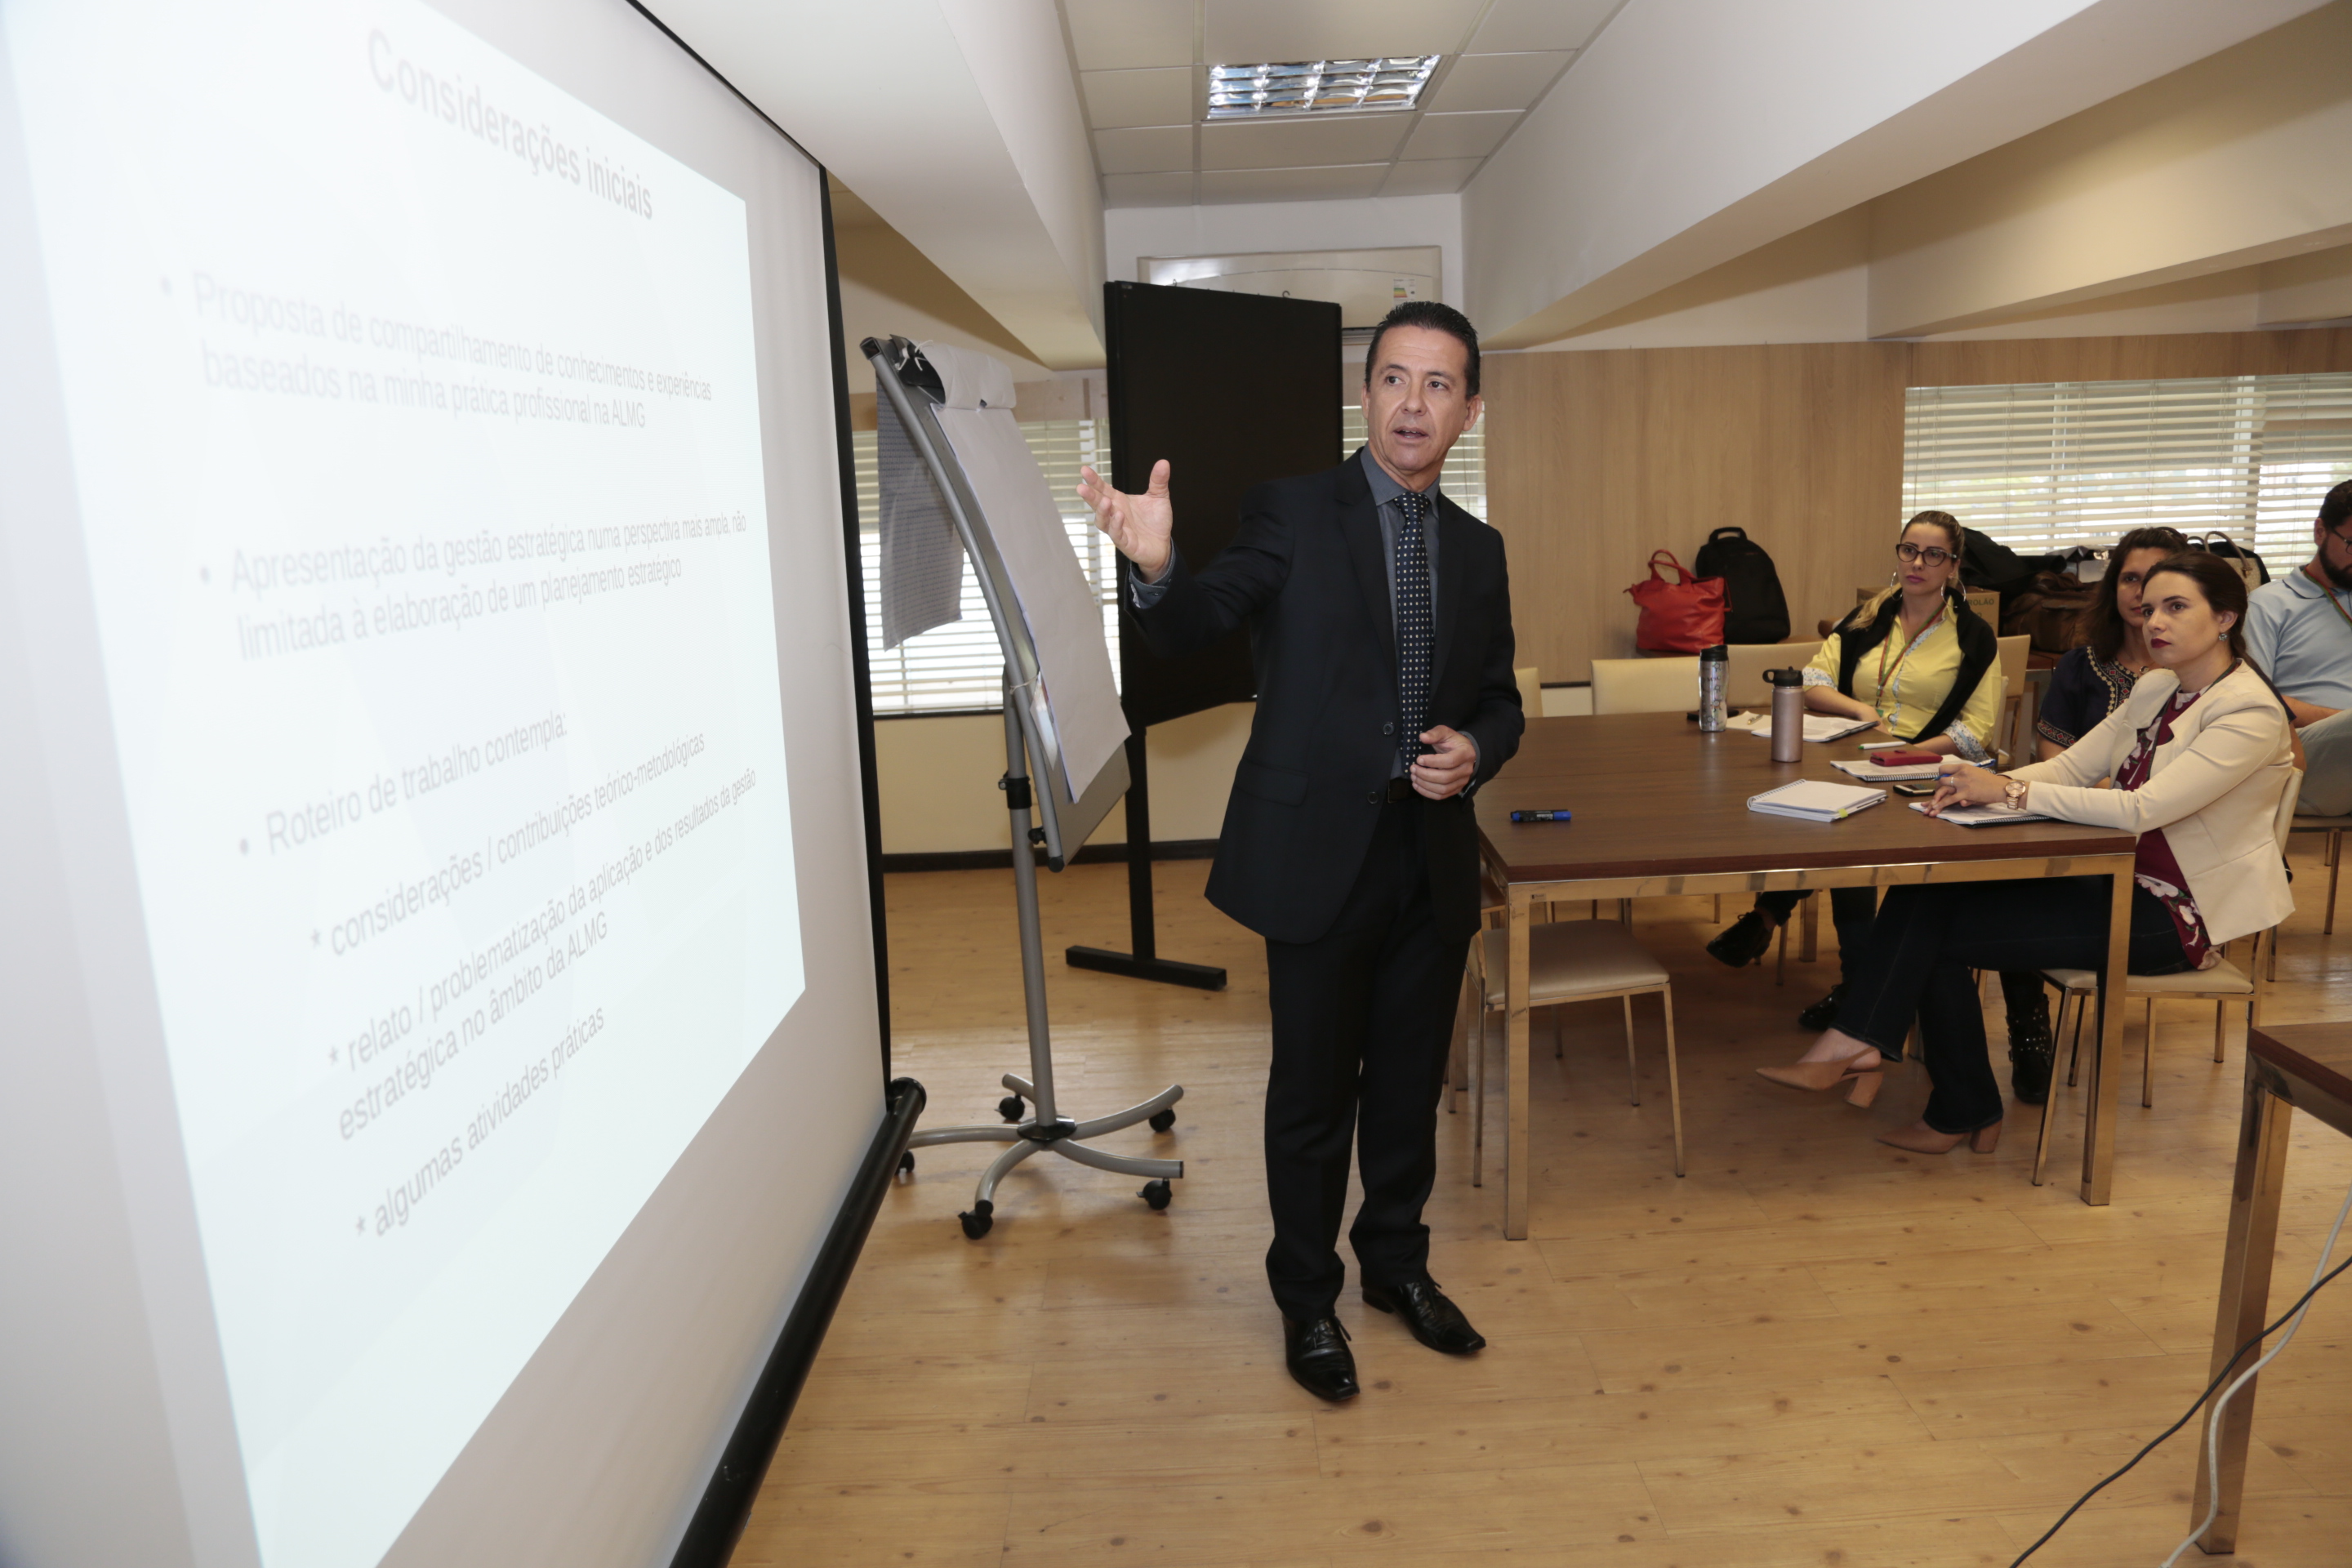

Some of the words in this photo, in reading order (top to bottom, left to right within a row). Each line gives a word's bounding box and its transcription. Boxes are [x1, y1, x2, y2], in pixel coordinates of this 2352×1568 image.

[368, 28, 581, 185] Considerações
[586, 145, 653, 220] iniciais
[192, 269, 327, 341] Proposta
[332, 300, 363, 345] de
[370, 315, 532, 372] compartilhamento
[536, 343, 554, 376] de
[557, 351, 645, 391] conhecimentos
[648, 372, 654, 392] e
[657, 371, 712, 401] experiências
[201, 336, 341, 400] baseados
[348, 369, 378, 403] na
[384, 369, 448, 410] minha
[451, 375, 510, 421] prática
[513, 386, 591, 425] profissional
[595, 402, 610, 425] na
[612, 399, 646, 429] ALMG
[231, 536, 408, 603] Apresentação
[412, 534, 440, 572] da
[444, 528, 503, 577] gestão
[507, 523, 586, 563] estratégica
[587, 526, 622, 551] numa
[624, 514, 681, 553] perspectiva
[683, 514, 703, 540] mais
[733, 510, 747, 533] não
[237, 604, 346, 662] limitada
[353, 596, 369, 640] à
[373, 584, 483, 632] elaboração
[488, 578, 510, 614] de
[513, 578, 537, 610] um
[541, 567, 626, 612] planejamento
[628, 552, 683, 587] estratégico
[265, 790, 363, 857] Roteiro
[368, 773, 398, 815] de
[401, 744, 481, 801] trabalho
[485, 710, 568, 768] contempla:
[331, 852, 483, 957] considerações
[497, 794, 593, 865] contribuições
[594, 732, 706, 811] teórico-metodológicas
[348, 1004, 412, 1073] relato
[430, 899, 566, 1023] problematização
[569, 884, 586, 916] da
[588, 845, 644, 904] aplicação
[644, 840, 653, 862] e
[654, 825, 674, 855] dos
[675, 795, 719, 842] resultados
[720, 784, 731, 808] da
[732, 768, 755, 805] gestão
[338, 1036, 460, 1142] estratégica
[461, 1008, 487, 1048] no
[489, 964, 544, 1026] âmbito
[546, 946, 567, 981] da
[568, 910, 609, 966] ALMG
[375, 1136, 464, 1238] algumas
[467, 1057, 550, 1152] atividades
[551, 1007, 605, 1080] práticas
